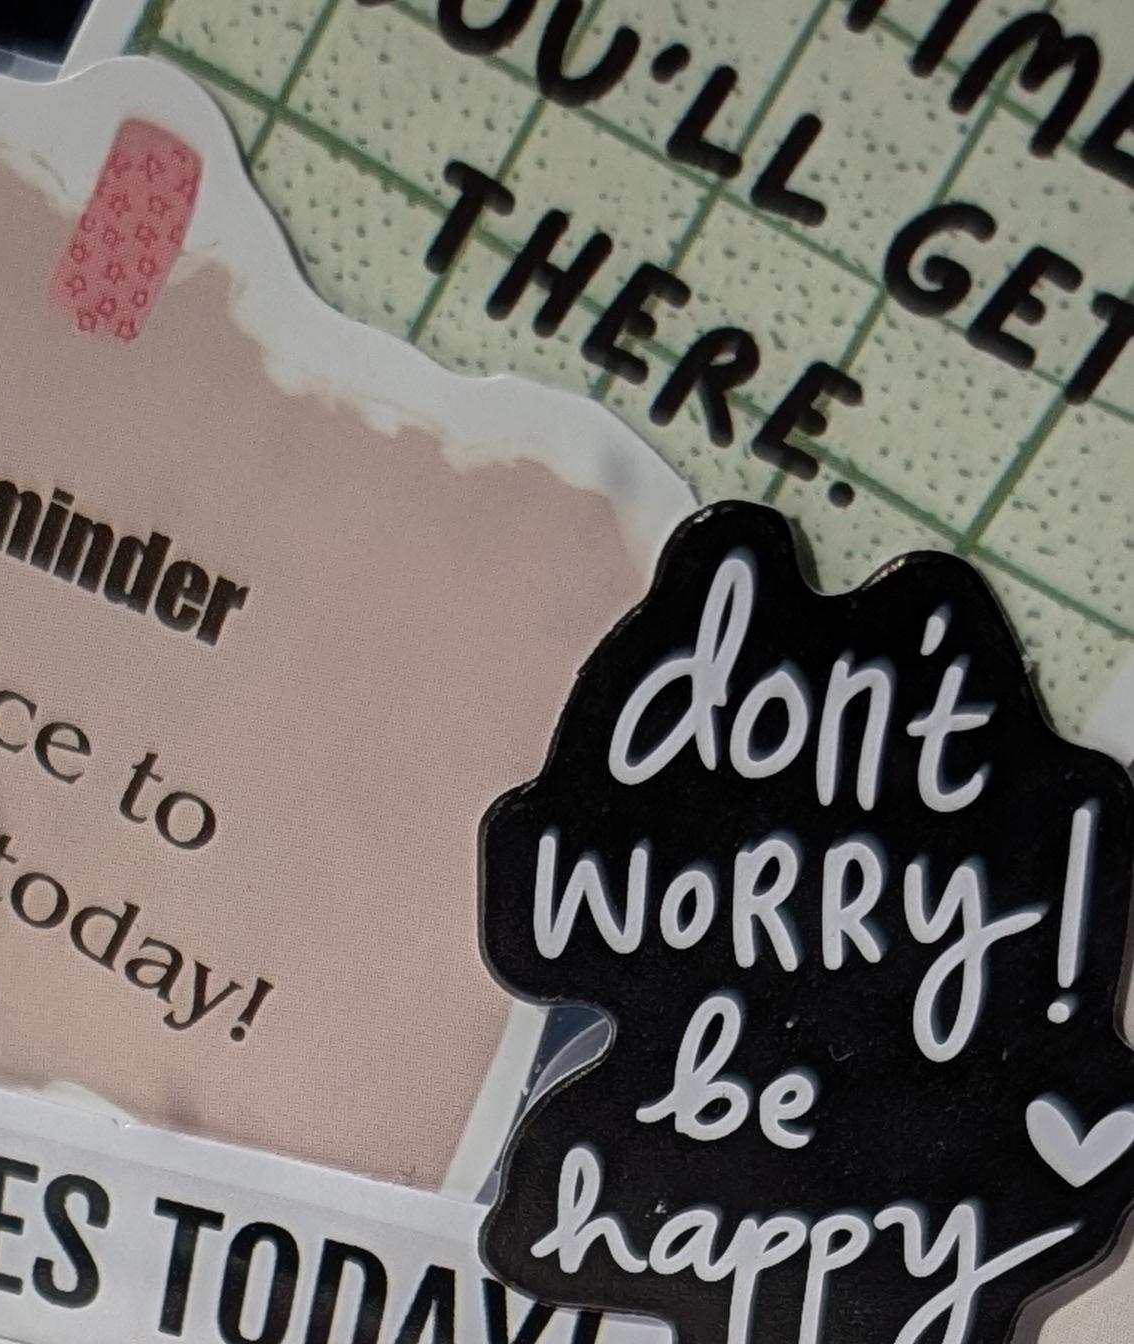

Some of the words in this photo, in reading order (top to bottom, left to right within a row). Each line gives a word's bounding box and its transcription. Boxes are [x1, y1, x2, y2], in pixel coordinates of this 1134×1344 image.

[356, 0, 828, 227] U'LL
[884, 202, 1134, 405] GET
[845, 0, 1134, 189] IM
[424, 159, 864, 508] THERE.
[607, 548, 996, 812] don't
[118, 751, 217, 851] to
[636, 995, 818, 1149] be
